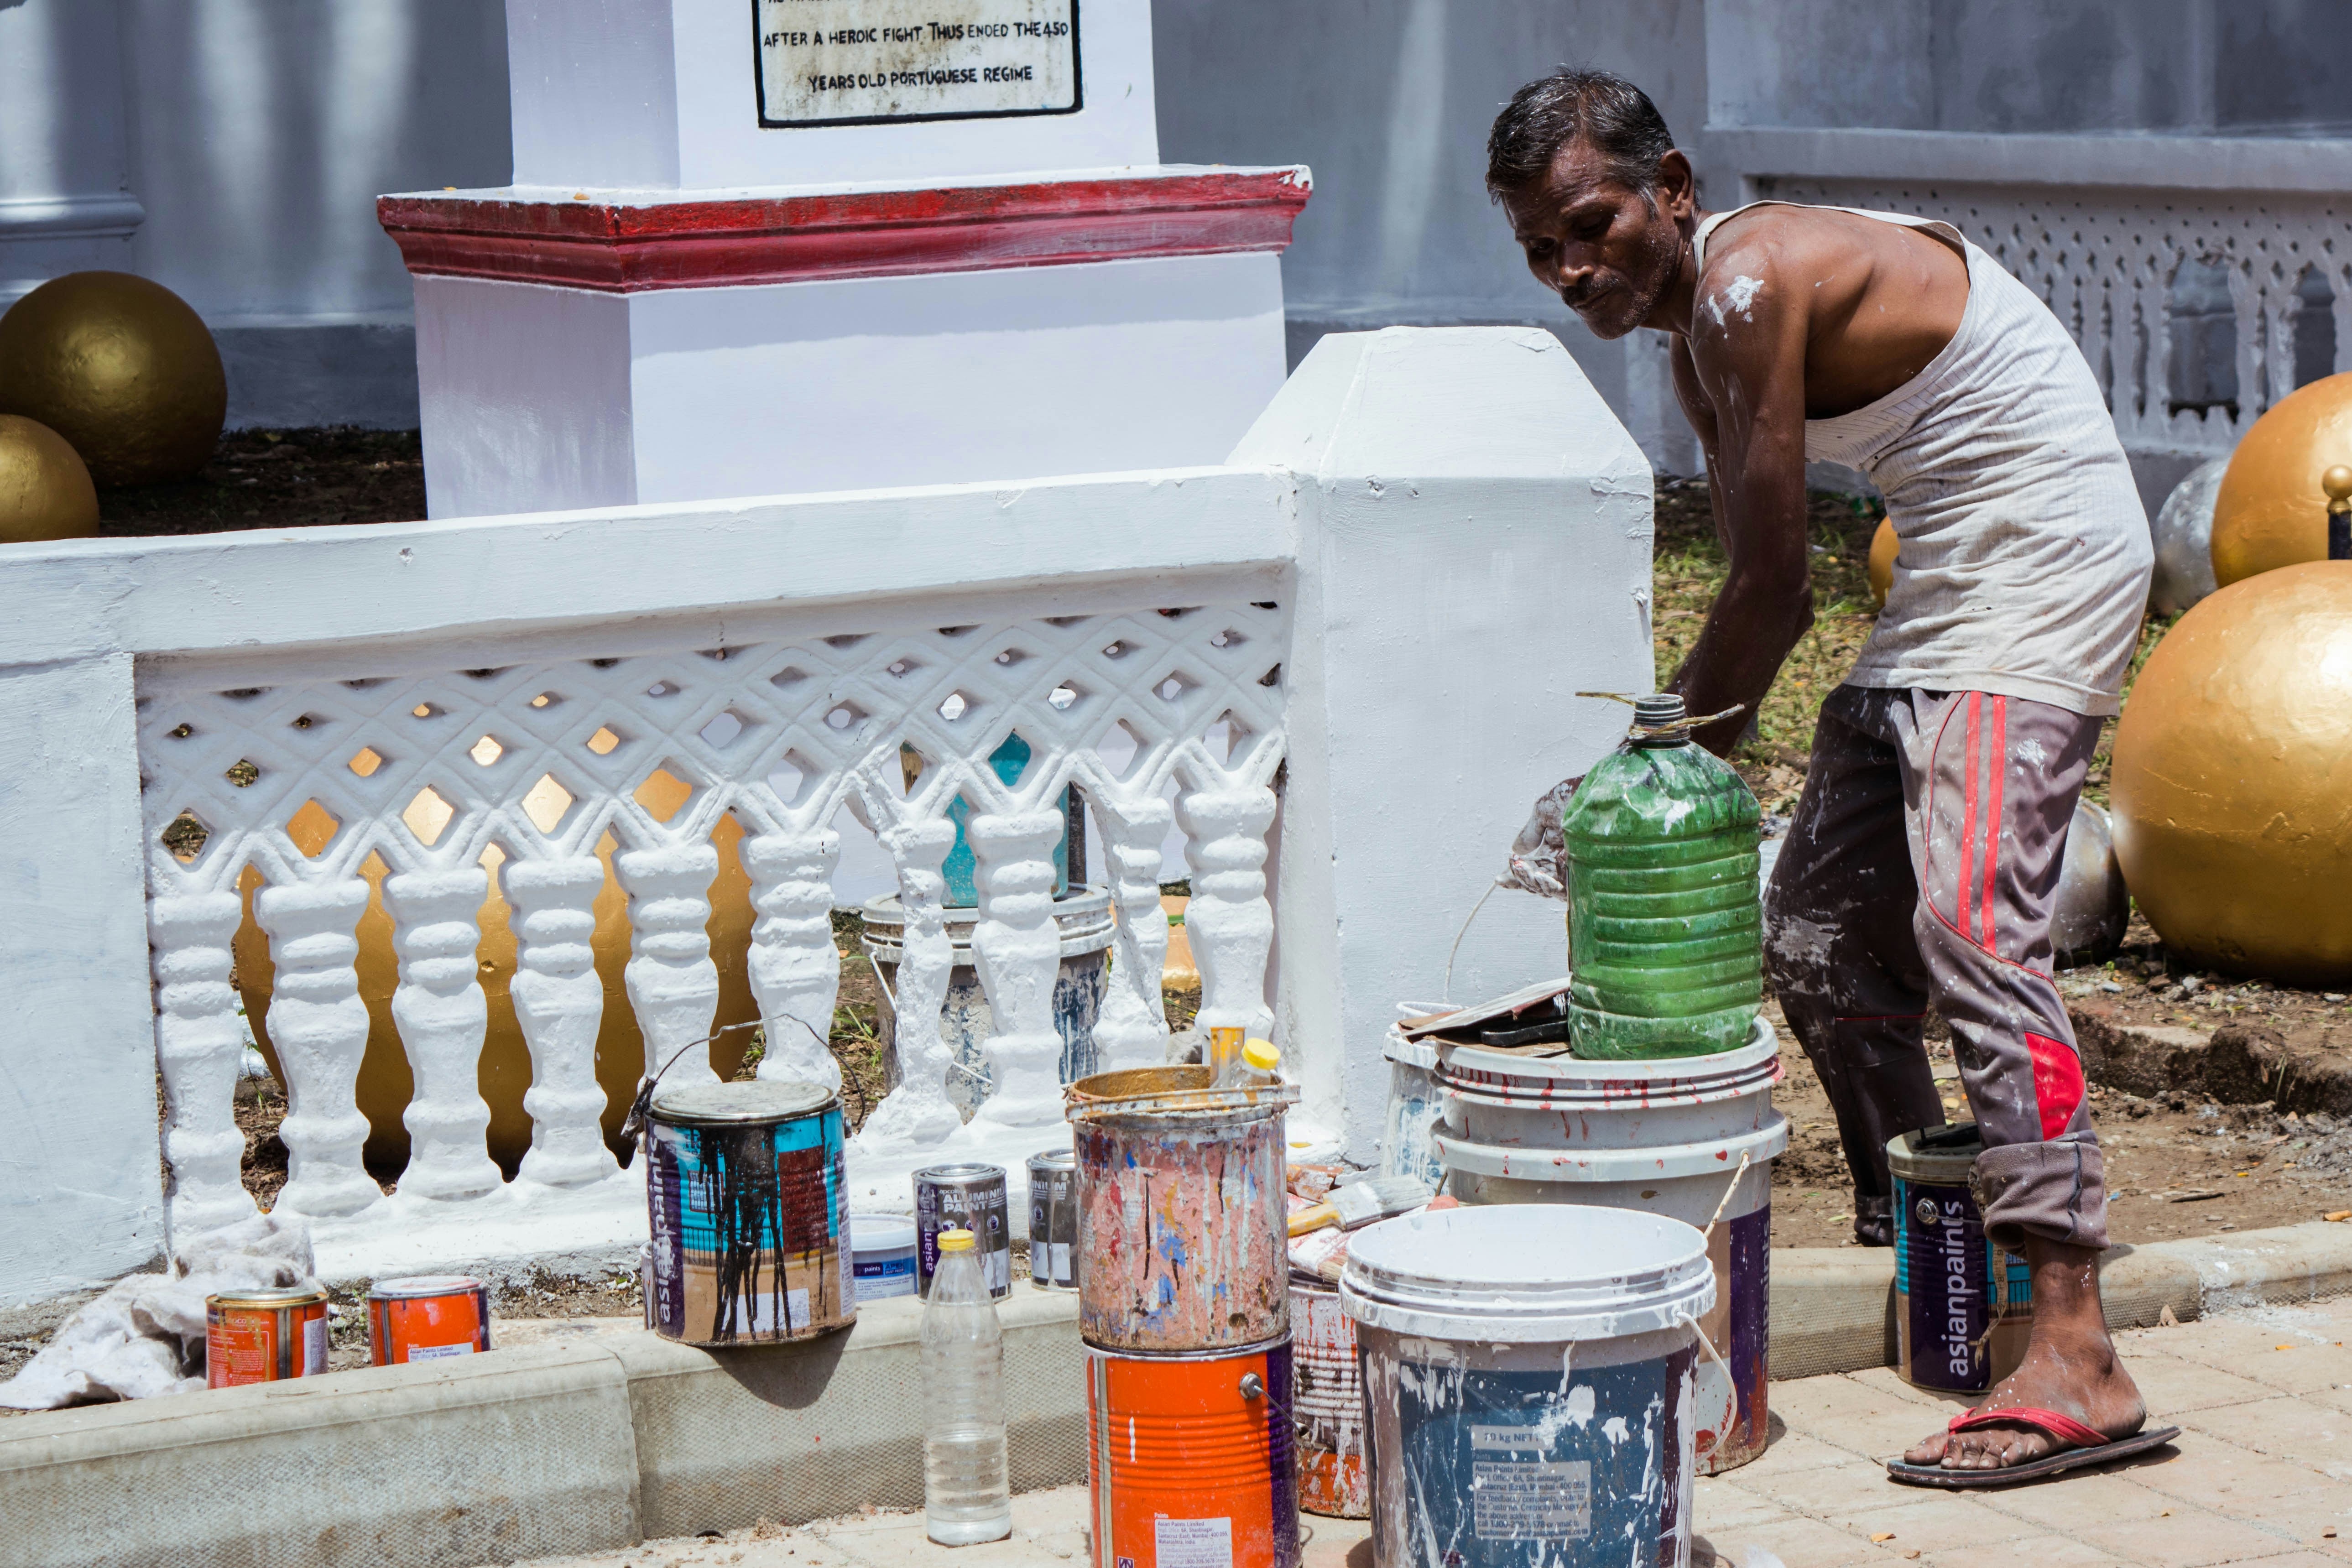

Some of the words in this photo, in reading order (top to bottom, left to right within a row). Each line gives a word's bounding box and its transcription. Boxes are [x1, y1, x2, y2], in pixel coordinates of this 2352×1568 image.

[764, 32, 808, 47] AFTER
[814, 31, 823, 46] A
[829, 28, 877, 44] HEROIC
[883, 26, 923, 43] FIGHT
[927, 21, 964, 42] THUS
[968, 24, 1008, 38] ENDED
[808, 74, 855, 93] YEARS
[858, 73, 887, 89] OLD
[890, 68, 977, 87] PORTUGUESE
[983, 65, 1033, 83] REGIME
[944, 1201, 987, 1213] PAINT
[649, 1137, 673, 1323] asiapaints
[1939, 1201, 1978, 1376] asianpaints
[1499, 1433, 1511, 1443] kg
[1513, 1474, 1524, 1483] 6A,
